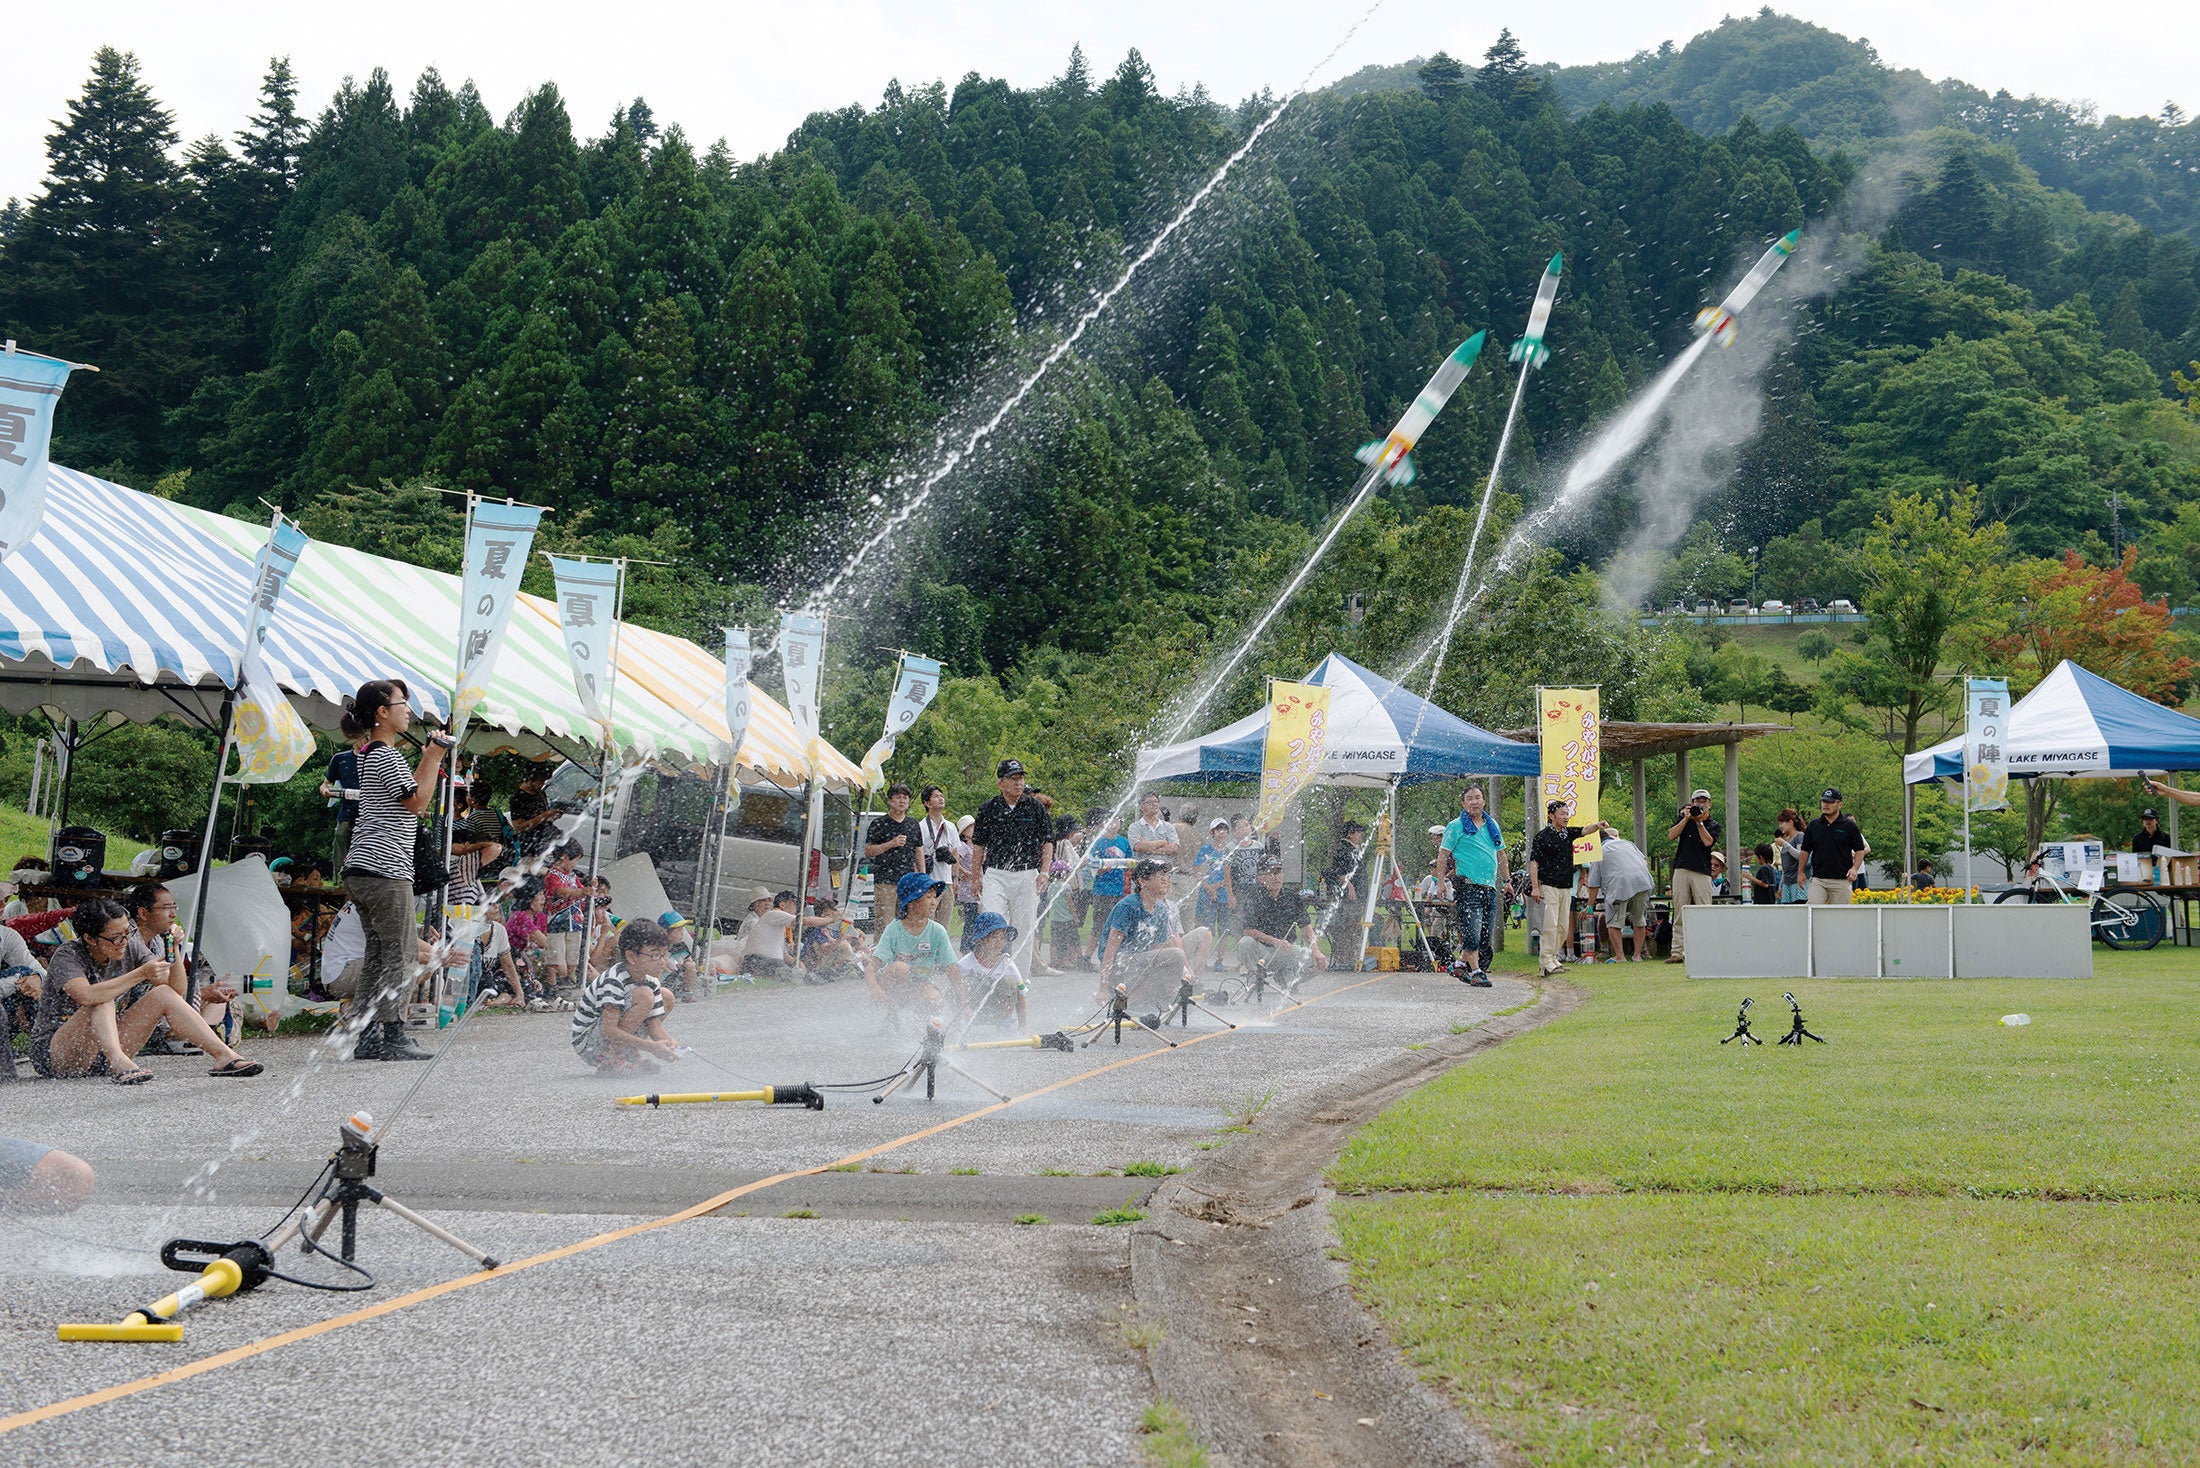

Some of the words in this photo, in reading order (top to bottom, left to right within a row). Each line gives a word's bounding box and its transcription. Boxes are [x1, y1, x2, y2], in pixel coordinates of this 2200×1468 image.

[1581, 710, 1598, 781] みやがせ
[1978, 697, 2001, 764] 夏の陣
[1342, 750, 1396, 760] MIYAGASE
[2009, 754, 2037, 763] LAKE
[2042, 752, 2099, 762] MIYAGASE
